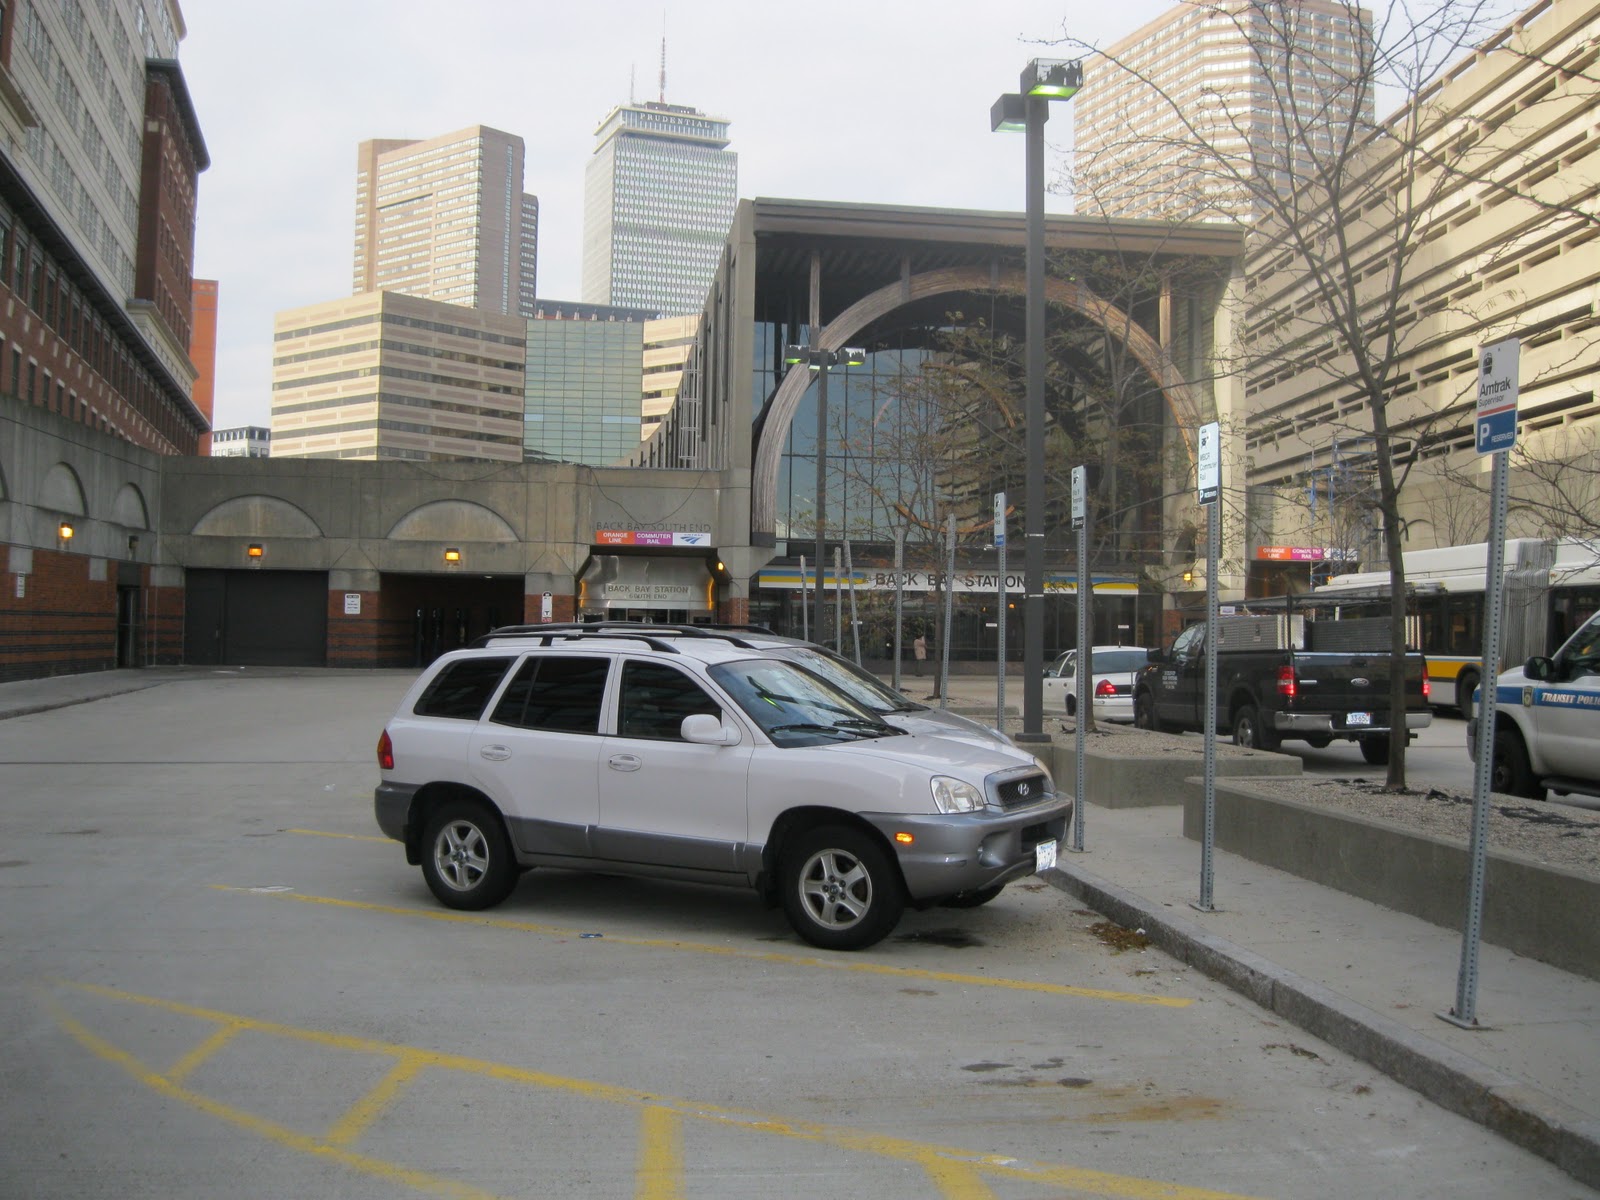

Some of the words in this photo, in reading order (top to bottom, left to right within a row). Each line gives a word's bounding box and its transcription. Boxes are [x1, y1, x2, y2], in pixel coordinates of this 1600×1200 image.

[640, 112, 711, 128] PRUDENTIAL
[1480, 376, 1511, 397] Amtrak
[1478, 394, 1505, 408] Supervisor
[1480, 423, 1490, 446] P
[1491, 431, 1514, 442] RESERVED
[596, 521, 624, 531] BACK
[627, 522, 646, 532] BAY
[651, 523, 687, 532] SOUTH
[689, 523, 712, 533] END
[965, 574, 1026, 588] STATON
[655, 586, 688, 594] STATION
[1541, 692, 1576, 704] TRANSIT
